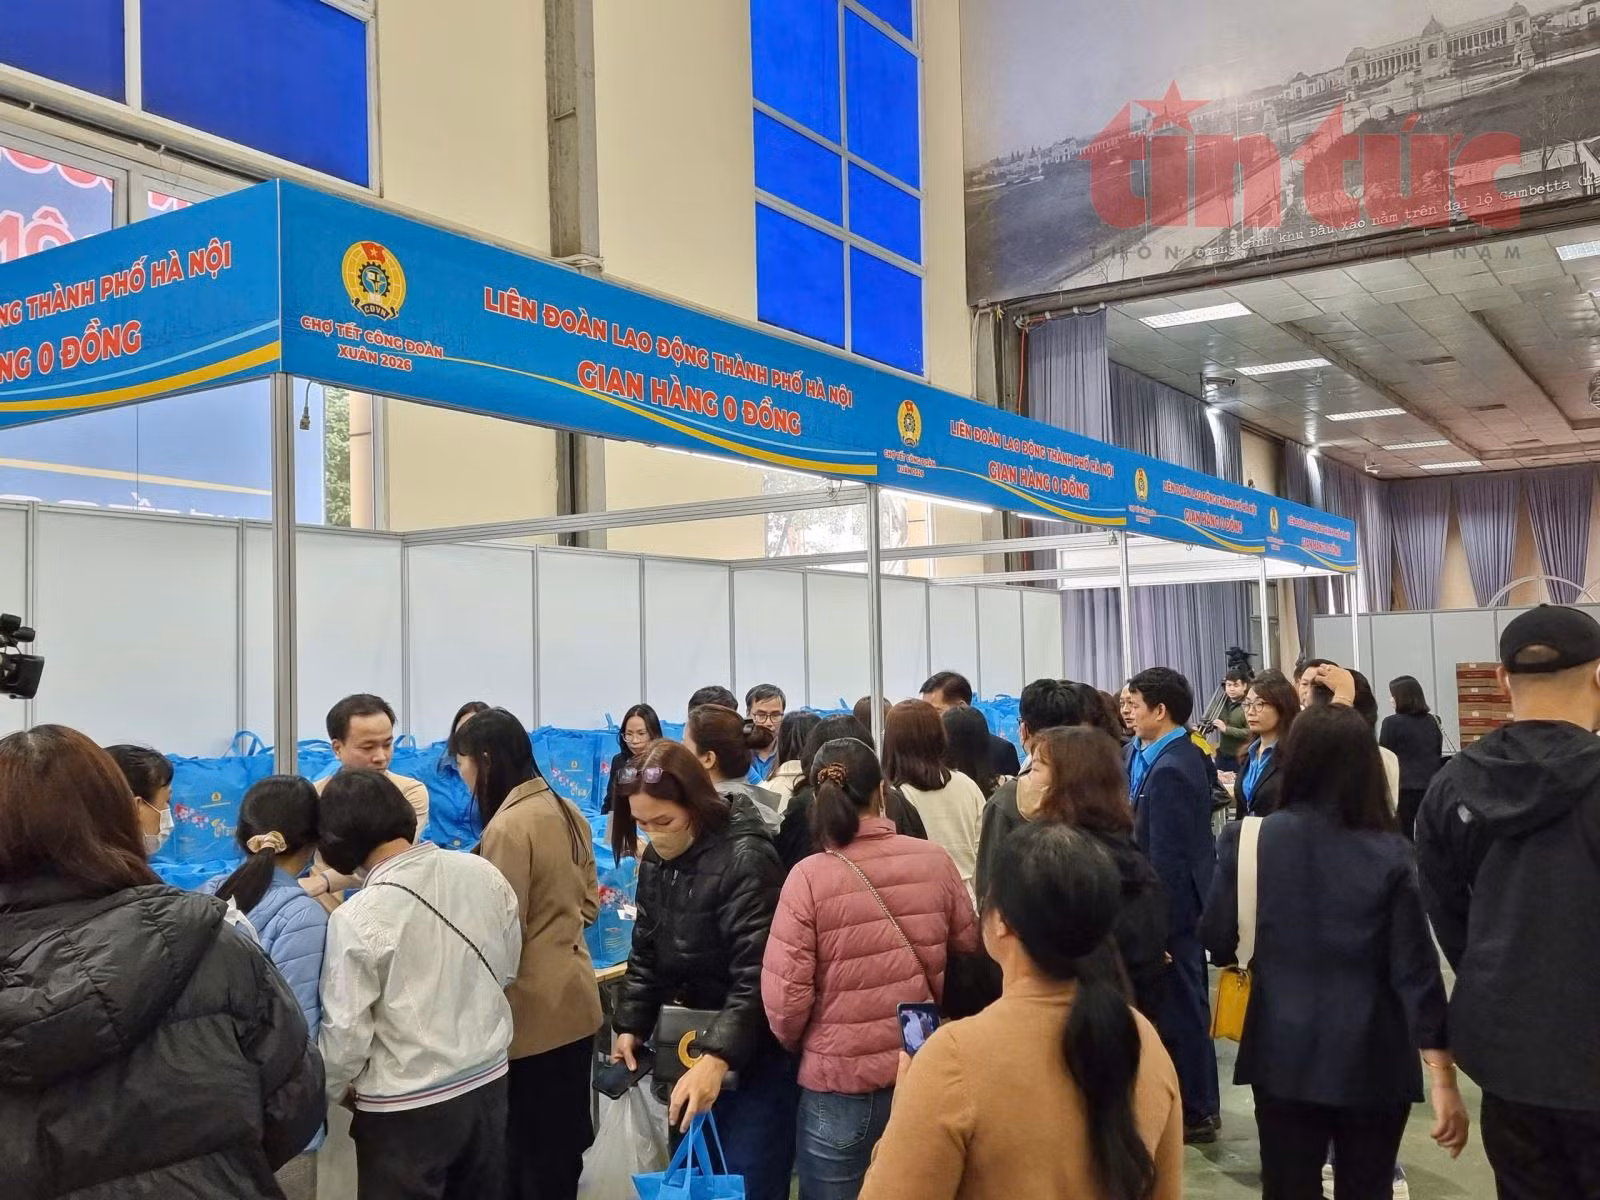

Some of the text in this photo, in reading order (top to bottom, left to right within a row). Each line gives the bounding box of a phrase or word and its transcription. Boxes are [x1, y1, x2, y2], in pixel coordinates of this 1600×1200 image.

[1278, 231, 1304, 244] khu
[1404, 204, 1439, 219] trên
[1499, 179, 1572, 202] Gambetta
[26, 283, 95, 320] THÀNH
[100, 255, 148, 301] PHỐ
[151, 250, 184, 288] HÀ
[188, 237, 232, 279] NỘI
[60, 318, 142, 370] ĐỒNG
[300, 315, 444, 358] CHỢ TẾT CÔNG ĐOÀN
[337, 343, 412, 372] XUÂN 2026
[484, 286, 853, 410] LIÊN ĐOÀN LAO ĐỘNG THÀNH PHỐ HÀ NỘI
[577, 360, 644, 401] GIAN
[650, 373, 718, 418] HÀNG
[741, 396, 801, 436] ĐỒNG
[950, 419, 972, 440] LIÊN
[973, 427, 1001, 448] ĐOÀN
[1002, 435, 1021, 453] LAO
[1021, 439, 1046, 461] ĐỘNG
[1047, 447, 1073, 468] THÀNH
[988, 460, 1017, 485] GIAN
[1019, 465, 1050, 493] HÀNG
[1061, 474, 1089, 500] ĐỒNG
